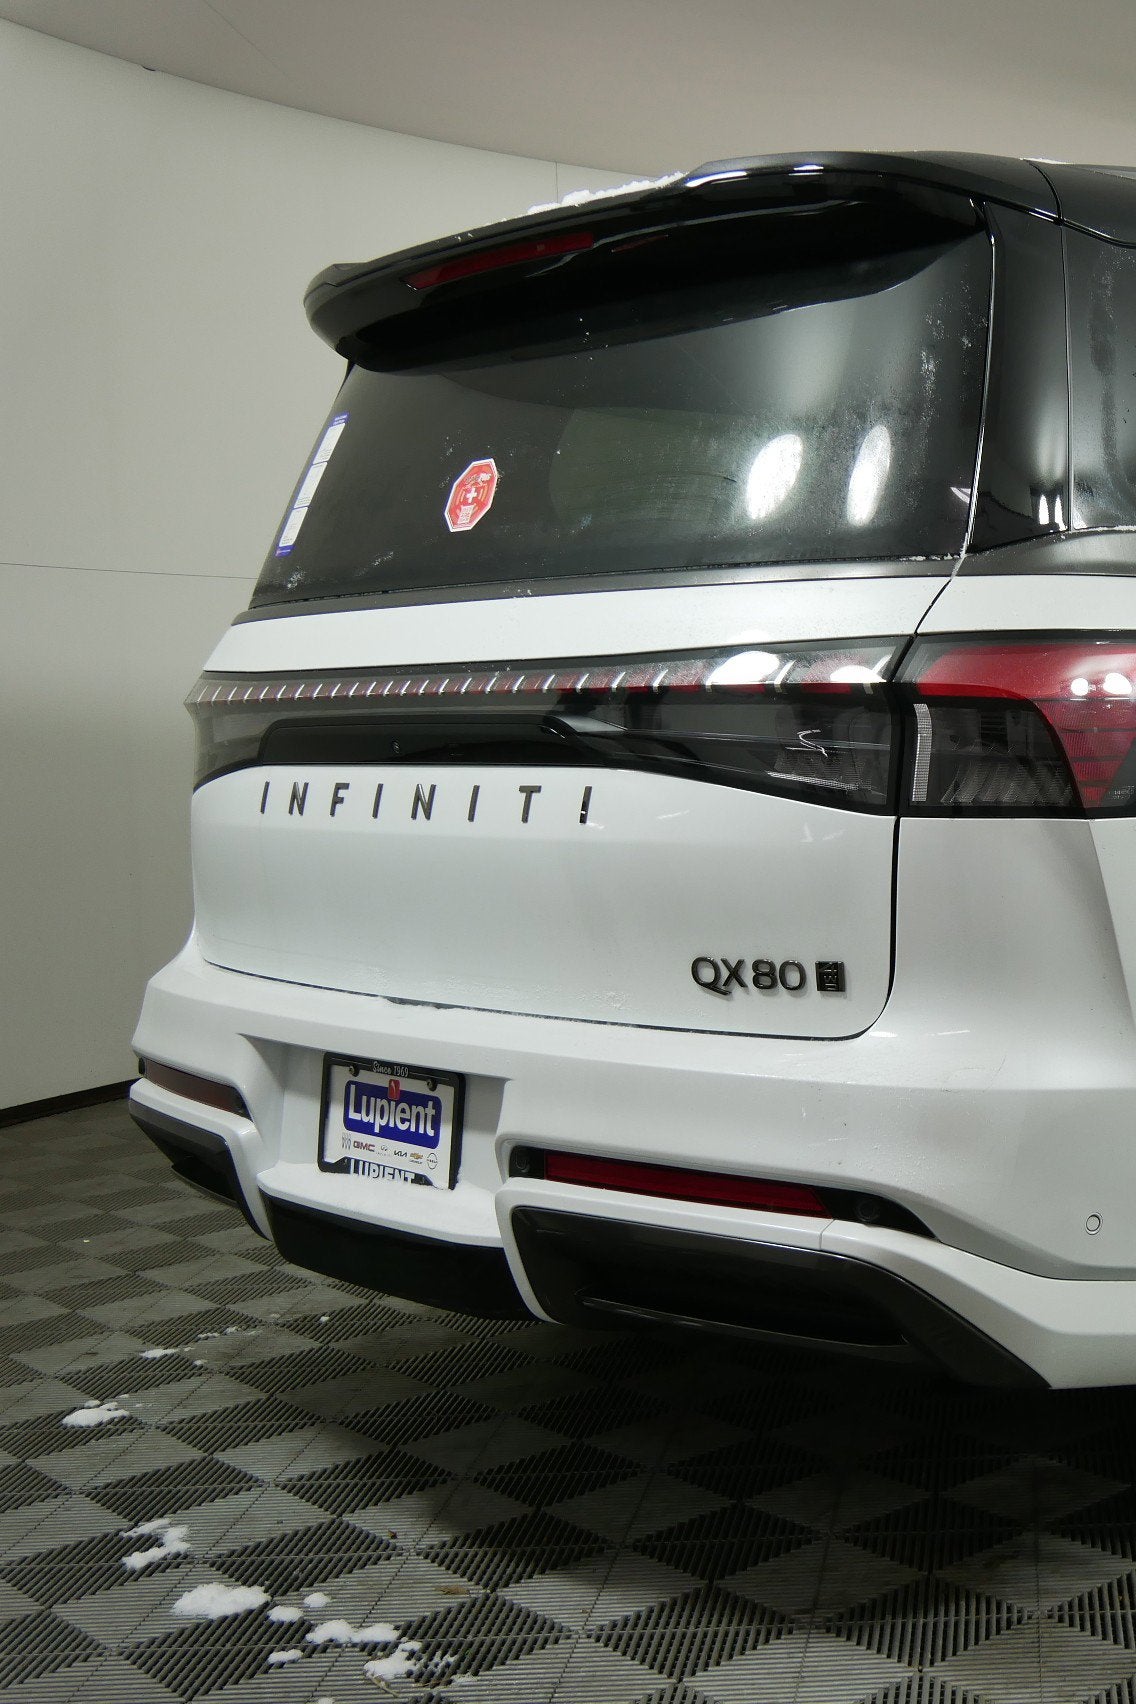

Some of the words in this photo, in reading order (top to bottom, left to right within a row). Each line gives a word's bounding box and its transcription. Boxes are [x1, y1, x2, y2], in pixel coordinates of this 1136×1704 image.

[260, 781, 593, 824] INFINITI
[691, 956, 807, 996] QX80
[372, 1060, 392, 1075] Since
[393, 1065, 409, 1078] 1969
[348, 1084, 436, 1137] Lupient
[353, 1140, 376, 1153] GMC
[349, 1158, 416, 1184] LUPIENT
